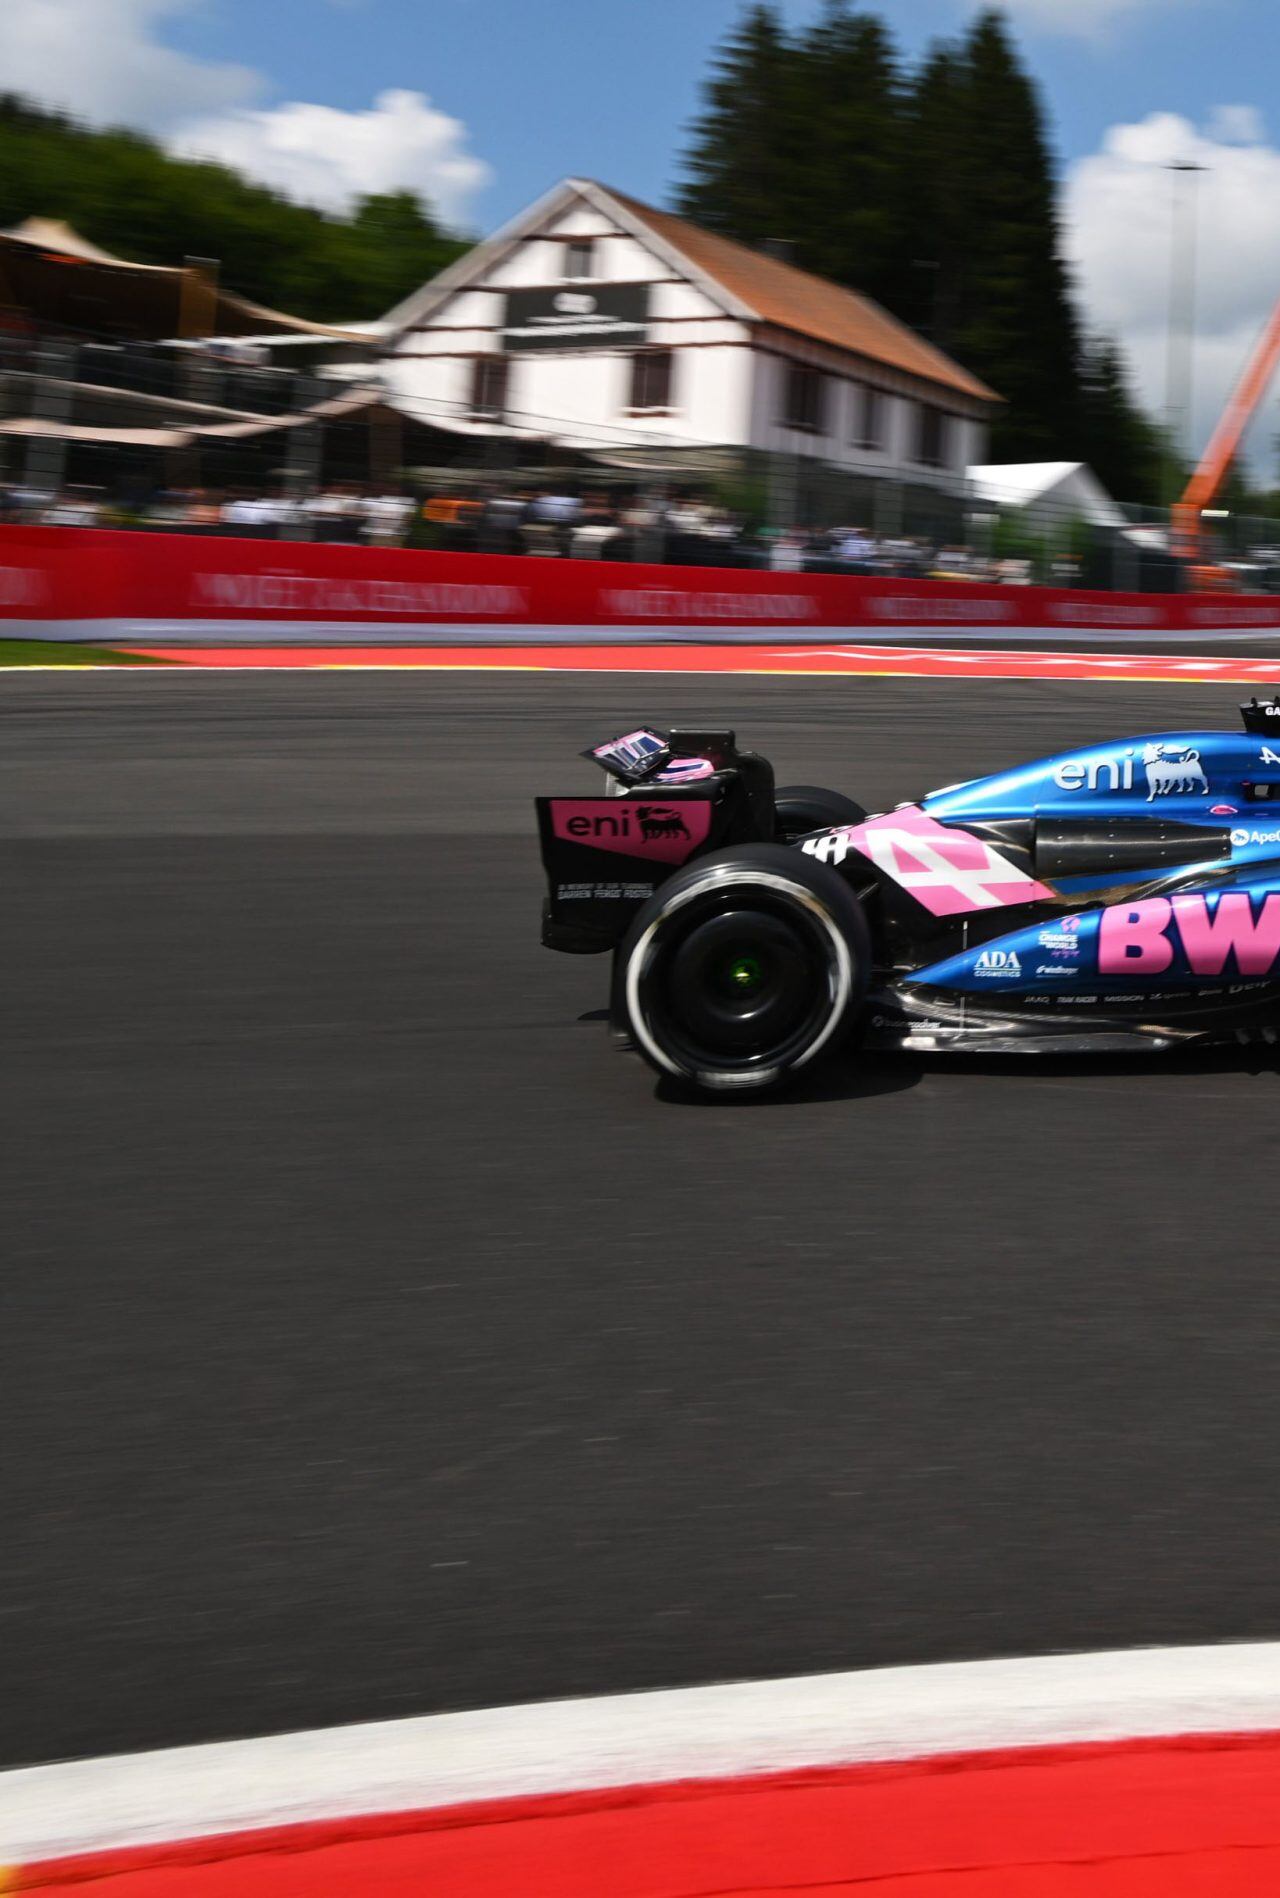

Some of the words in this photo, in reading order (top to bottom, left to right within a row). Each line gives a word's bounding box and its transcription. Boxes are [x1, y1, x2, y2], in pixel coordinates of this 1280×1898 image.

[1053, 748, 1134, 790] eni
[566, 809, 630, 837] eni
[974, 951, 1022, 968] ADA
